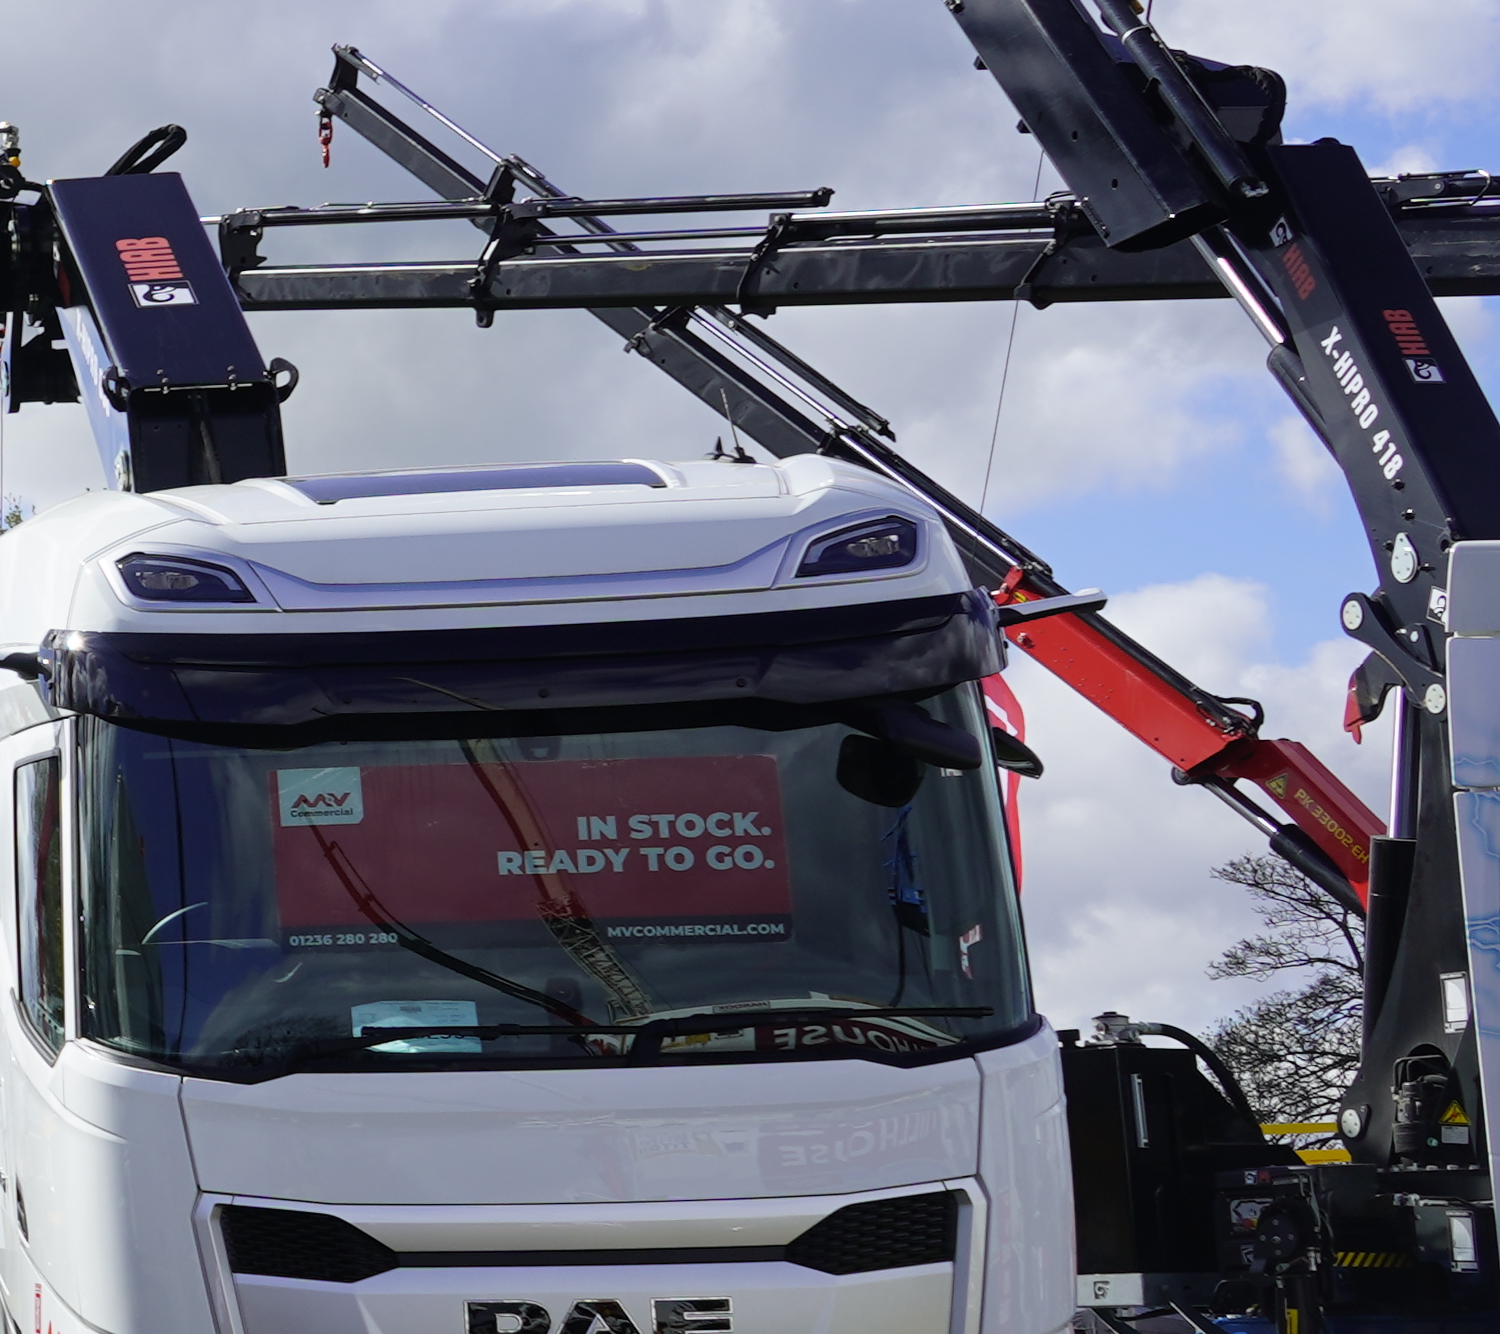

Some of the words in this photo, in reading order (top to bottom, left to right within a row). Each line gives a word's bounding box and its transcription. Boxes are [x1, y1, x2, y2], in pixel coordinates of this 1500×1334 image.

[115, 236, 184, 281] HIAB
[1282, 242, 1316, 300] HIAB
[1382, 309, 1430, 355] HIAB
[1321, 325, 1379, 430] X-HIPRO
[1372, 429, 1404, 480] 418
[290, 807, 353, 818] Commercial
[1294, 789, 1314, 808] PK
[577, 815, 617, 841] IN
[629, 810, 772, 839] STOCK.
[497, 848, 629, 875] READY
[639, 845, 694, 873] TO
[705, 843, 775, 870] GO.
[288, 933, 332, 947] 01236
[336, 932, 365, 945] 280
[368, 931, 397, 944] 280
[607, 922, 784, 938] MVCOMMERCIAL.COM
